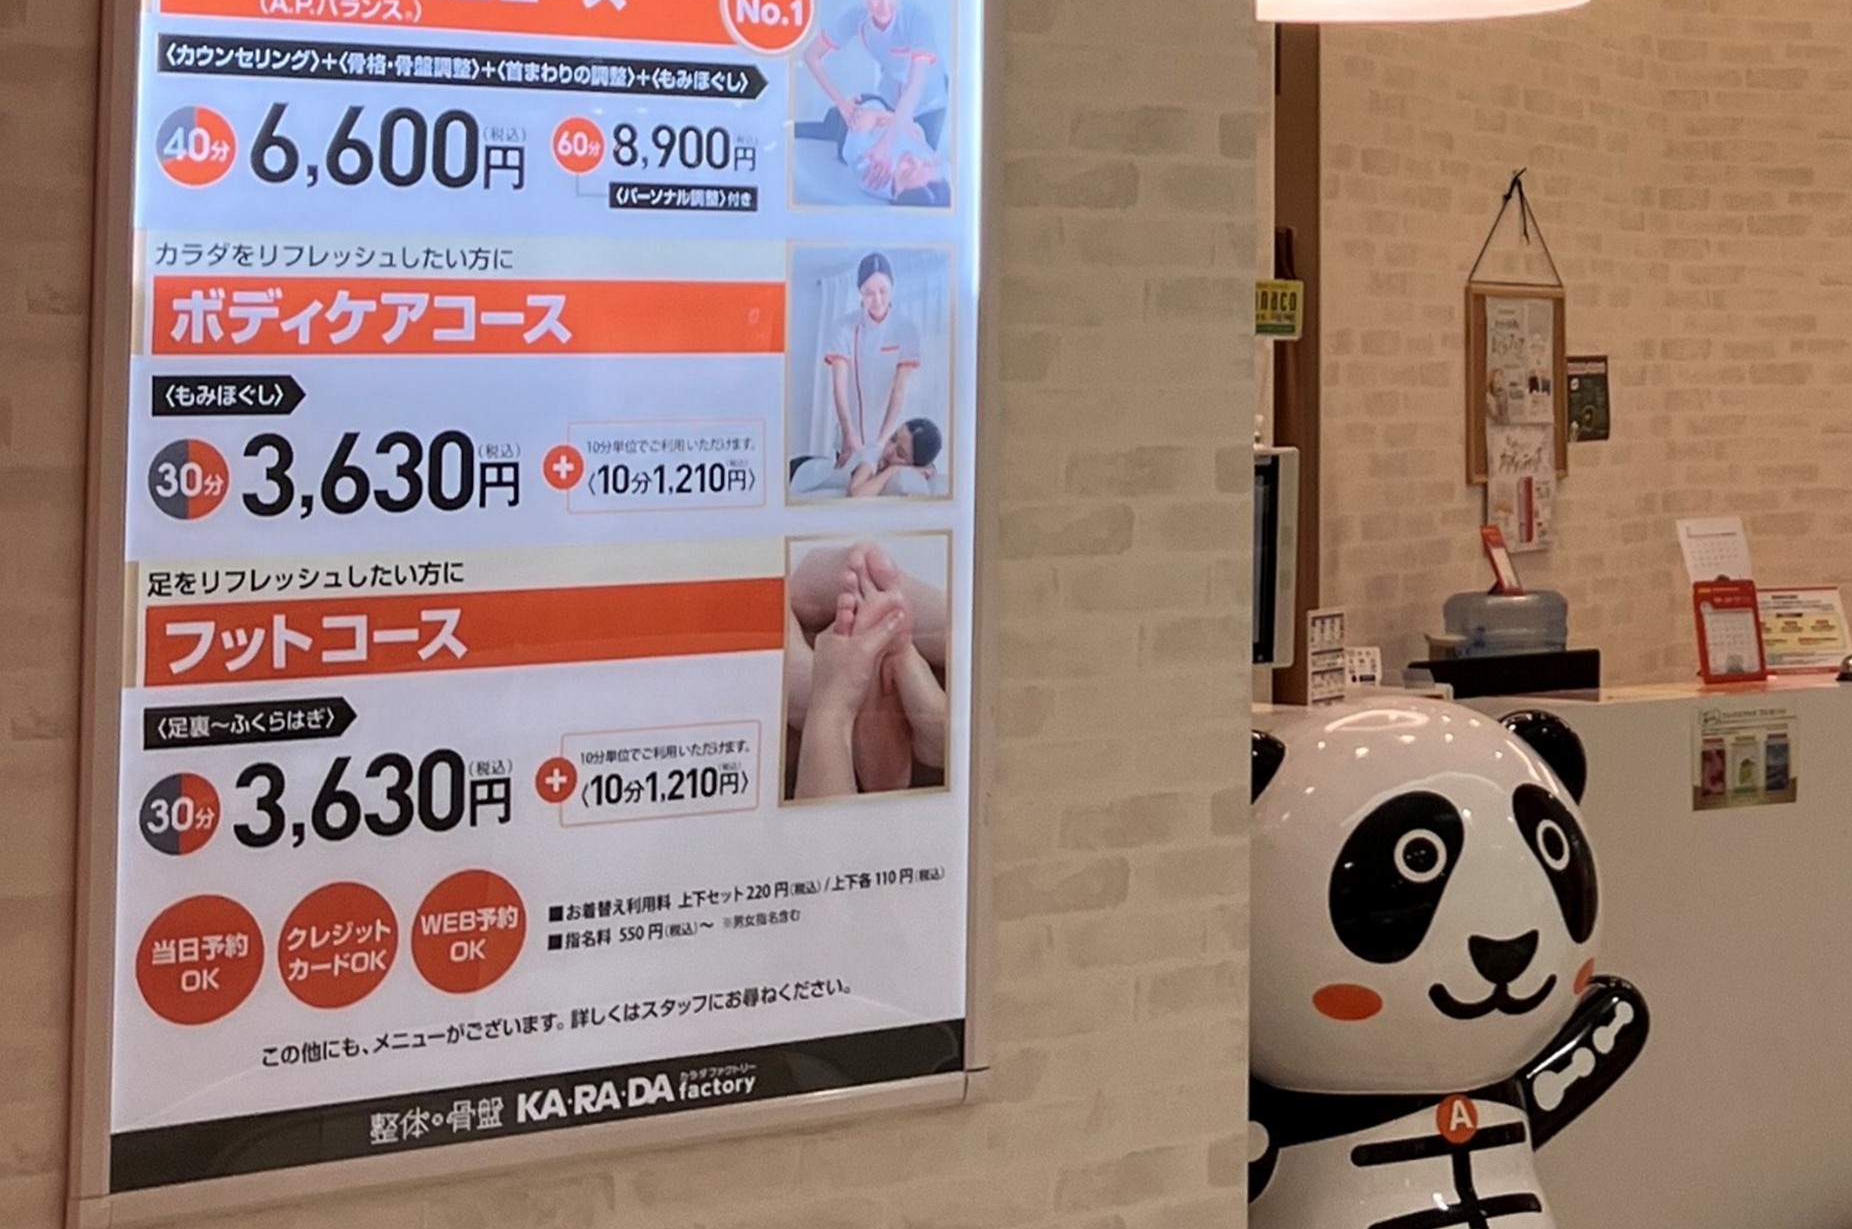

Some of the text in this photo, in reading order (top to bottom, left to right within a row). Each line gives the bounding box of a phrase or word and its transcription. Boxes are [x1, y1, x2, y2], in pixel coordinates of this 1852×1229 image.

[162, 126, 230, 163] 40分
[251, 102, 525, 190] 6,600円
[557, 130, 601, 158] 60分
[612, 123, 756, 172] 8,900円
[156, 241, 514, 270] カラダをリフレッシュしたい方に
[170, 290, 573, 347] ボディケアコース
[165, 383, 284, 408] 〈もみほぐし〉
[155, 461, 224, 497] 30分
[242, 430, 521, 519] 3,630円
[147, 561, 465, 597] 足をリフレッシュしたい方に
[165, 610, 468, 674] フットコース
[146, 795, 215, 834] 30分
[233, 748, 512, 848] 3,630円
[286, 919, 392, 952] クレジット
[420, 904, 519, 936] WEB予約
[152, 933, 249, 966] 当日予約
[450, 940, 487, 964] OK
[565, 927, 611, 950] 指名料
[181, 969, 220, 993] OK
[288, 950, 387, 982] カードOK
[678, 1073, 756, 1101] factory
[1451, 1100, 1474, 1131] A
